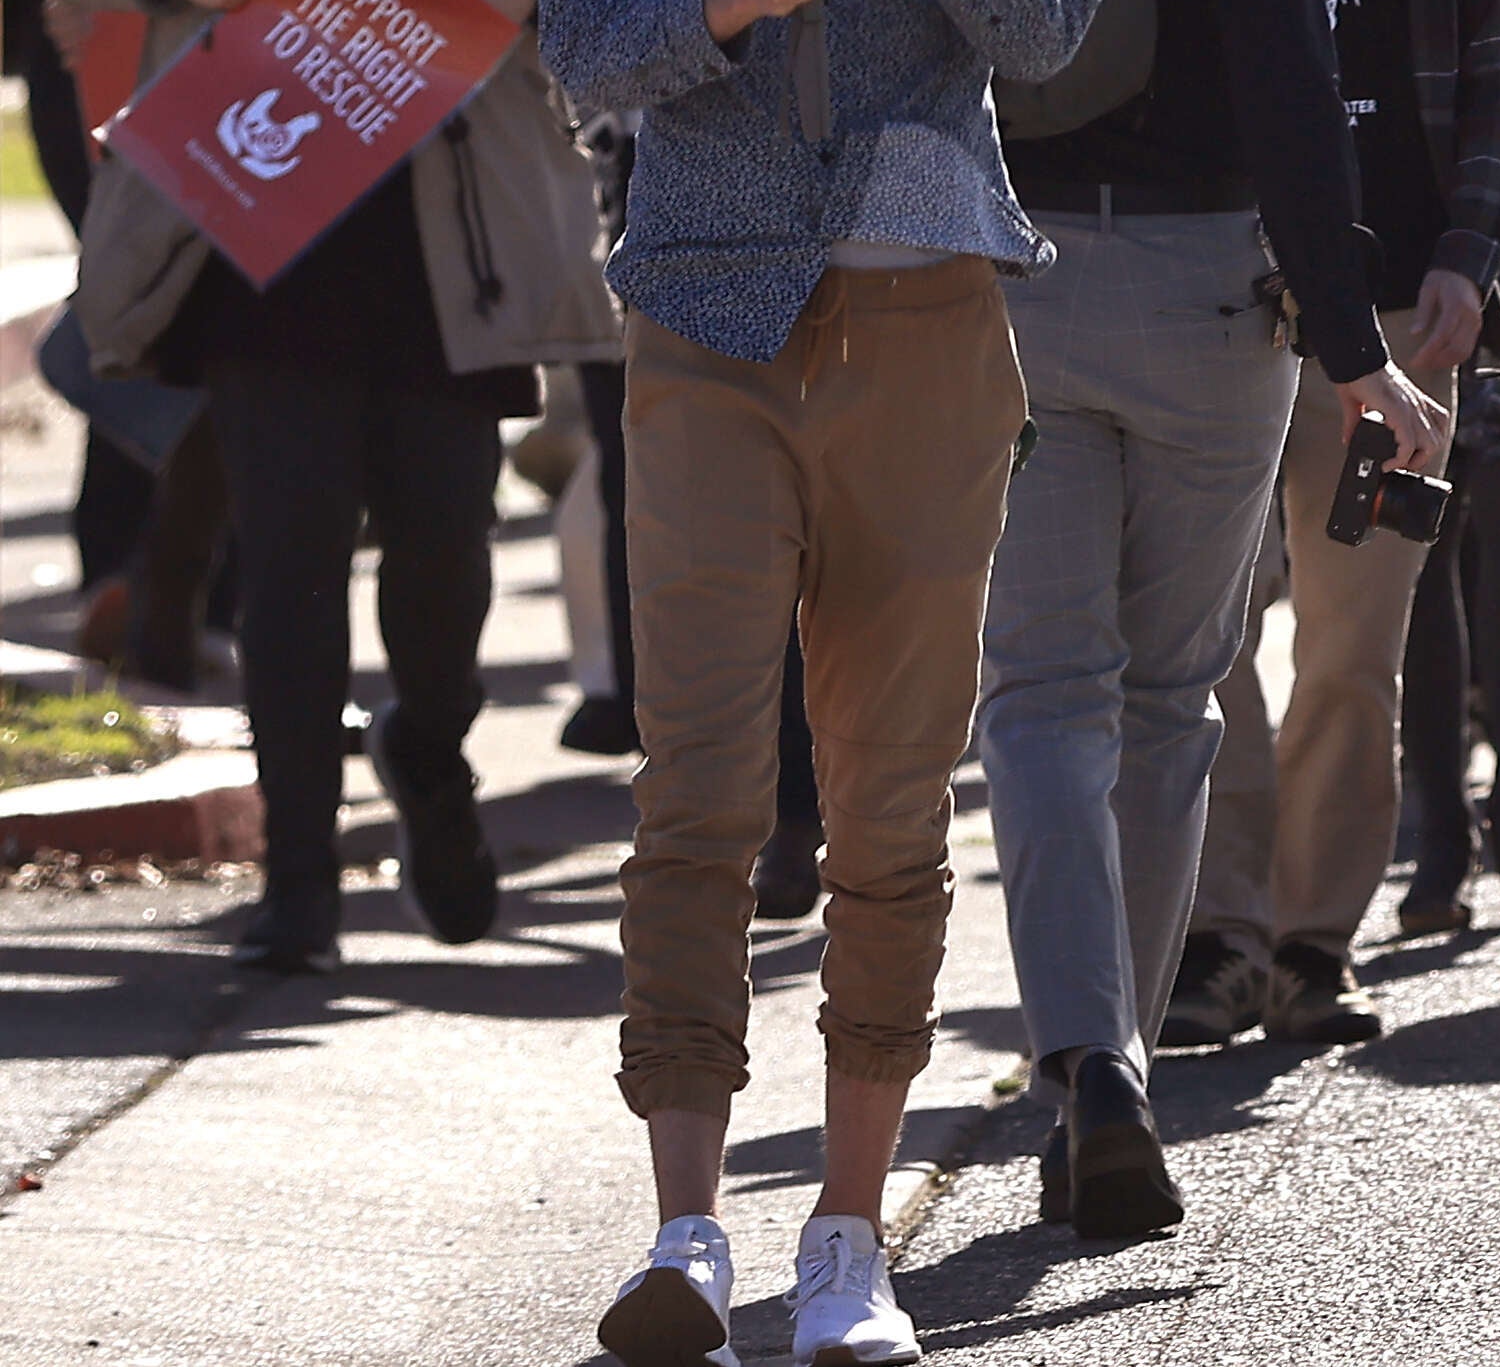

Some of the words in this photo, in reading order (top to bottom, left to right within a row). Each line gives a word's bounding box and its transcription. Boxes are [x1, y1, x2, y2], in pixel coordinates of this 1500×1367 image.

[262, 10, 310, 60] TO
[292, 43, 399, 146] RESCUE
[339, 25, 429, 108] RIGHT
